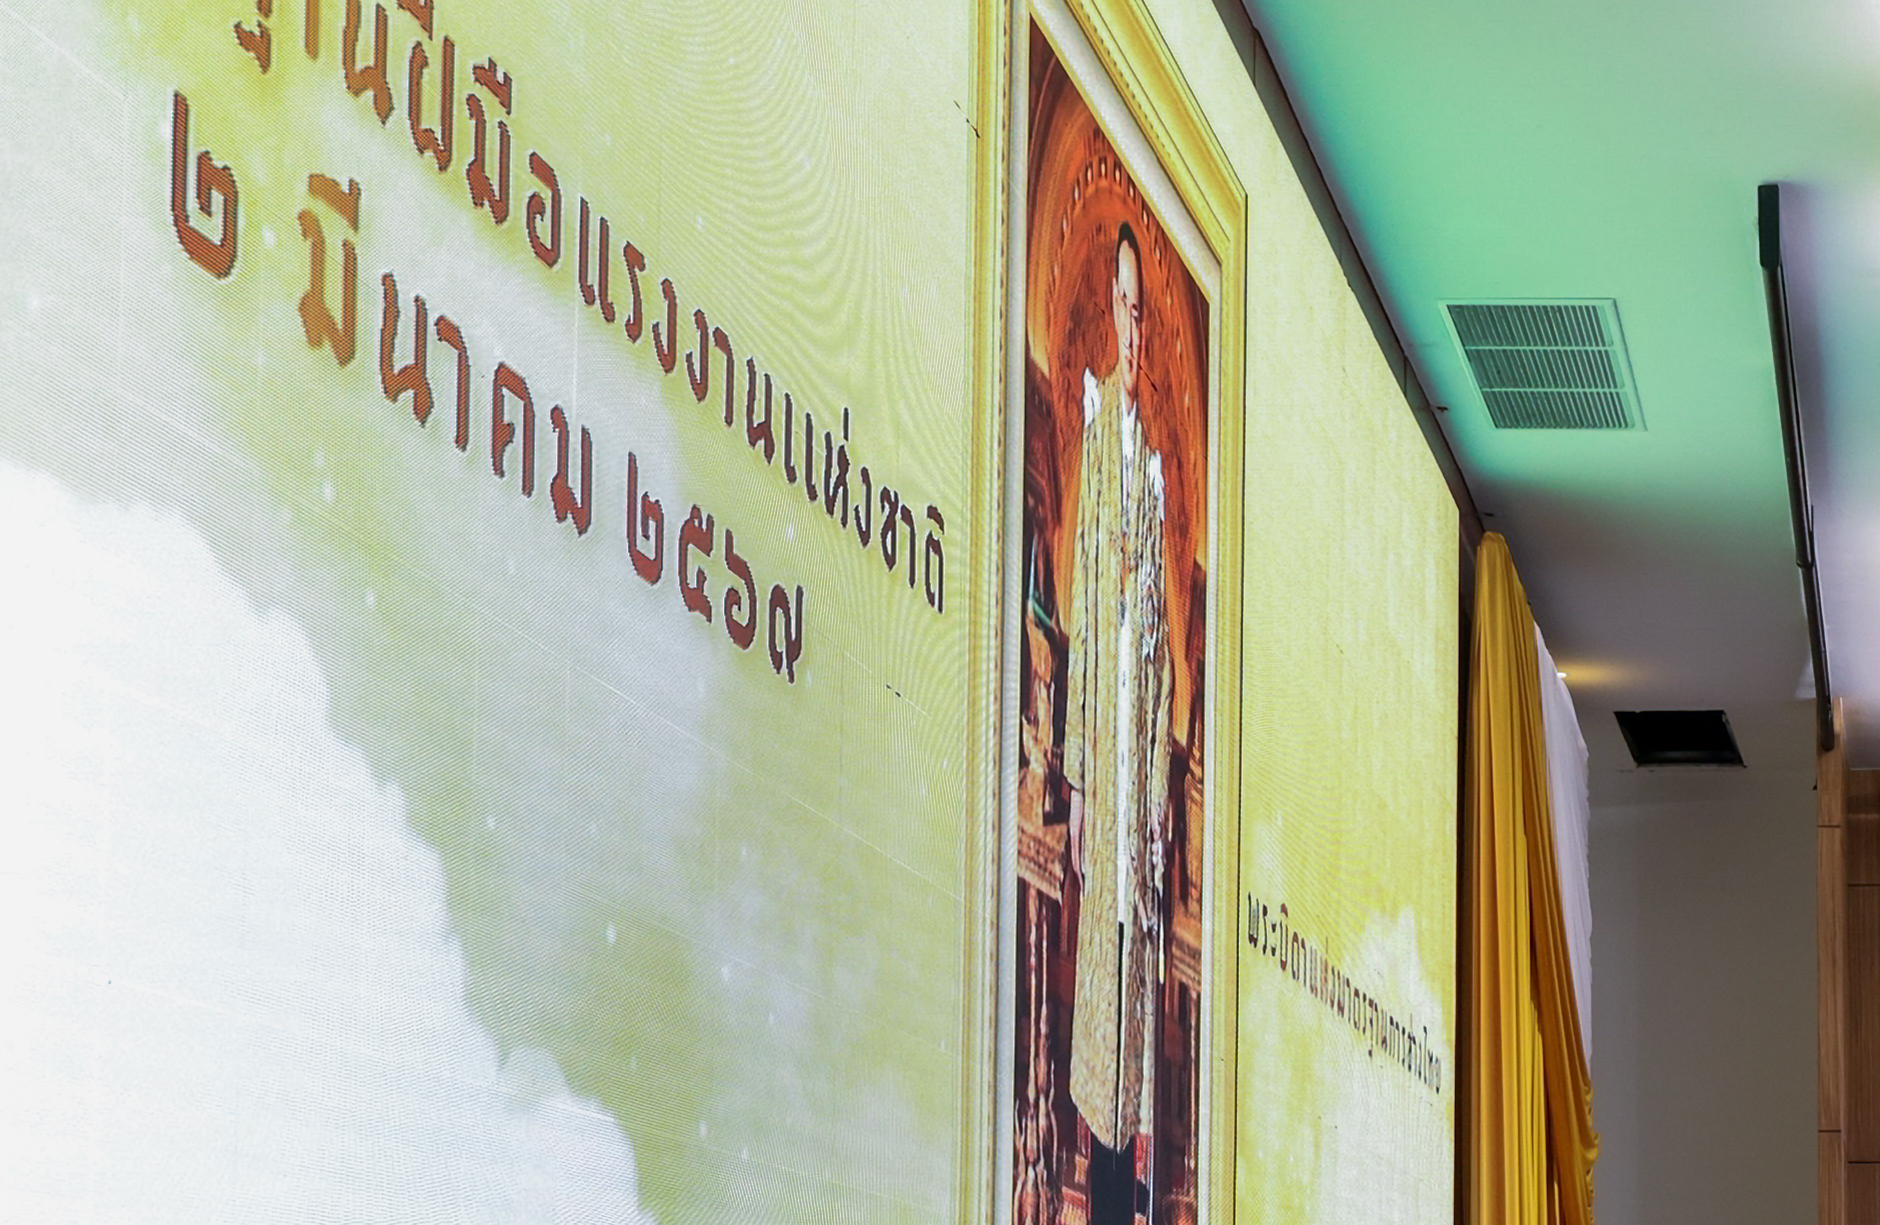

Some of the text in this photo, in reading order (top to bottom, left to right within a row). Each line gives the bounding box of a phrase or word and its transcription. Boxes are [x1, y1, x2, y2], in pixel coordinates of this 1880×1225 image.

[171, 91, 804, 684] ๒ มีนาคม ๒๕๖๙
